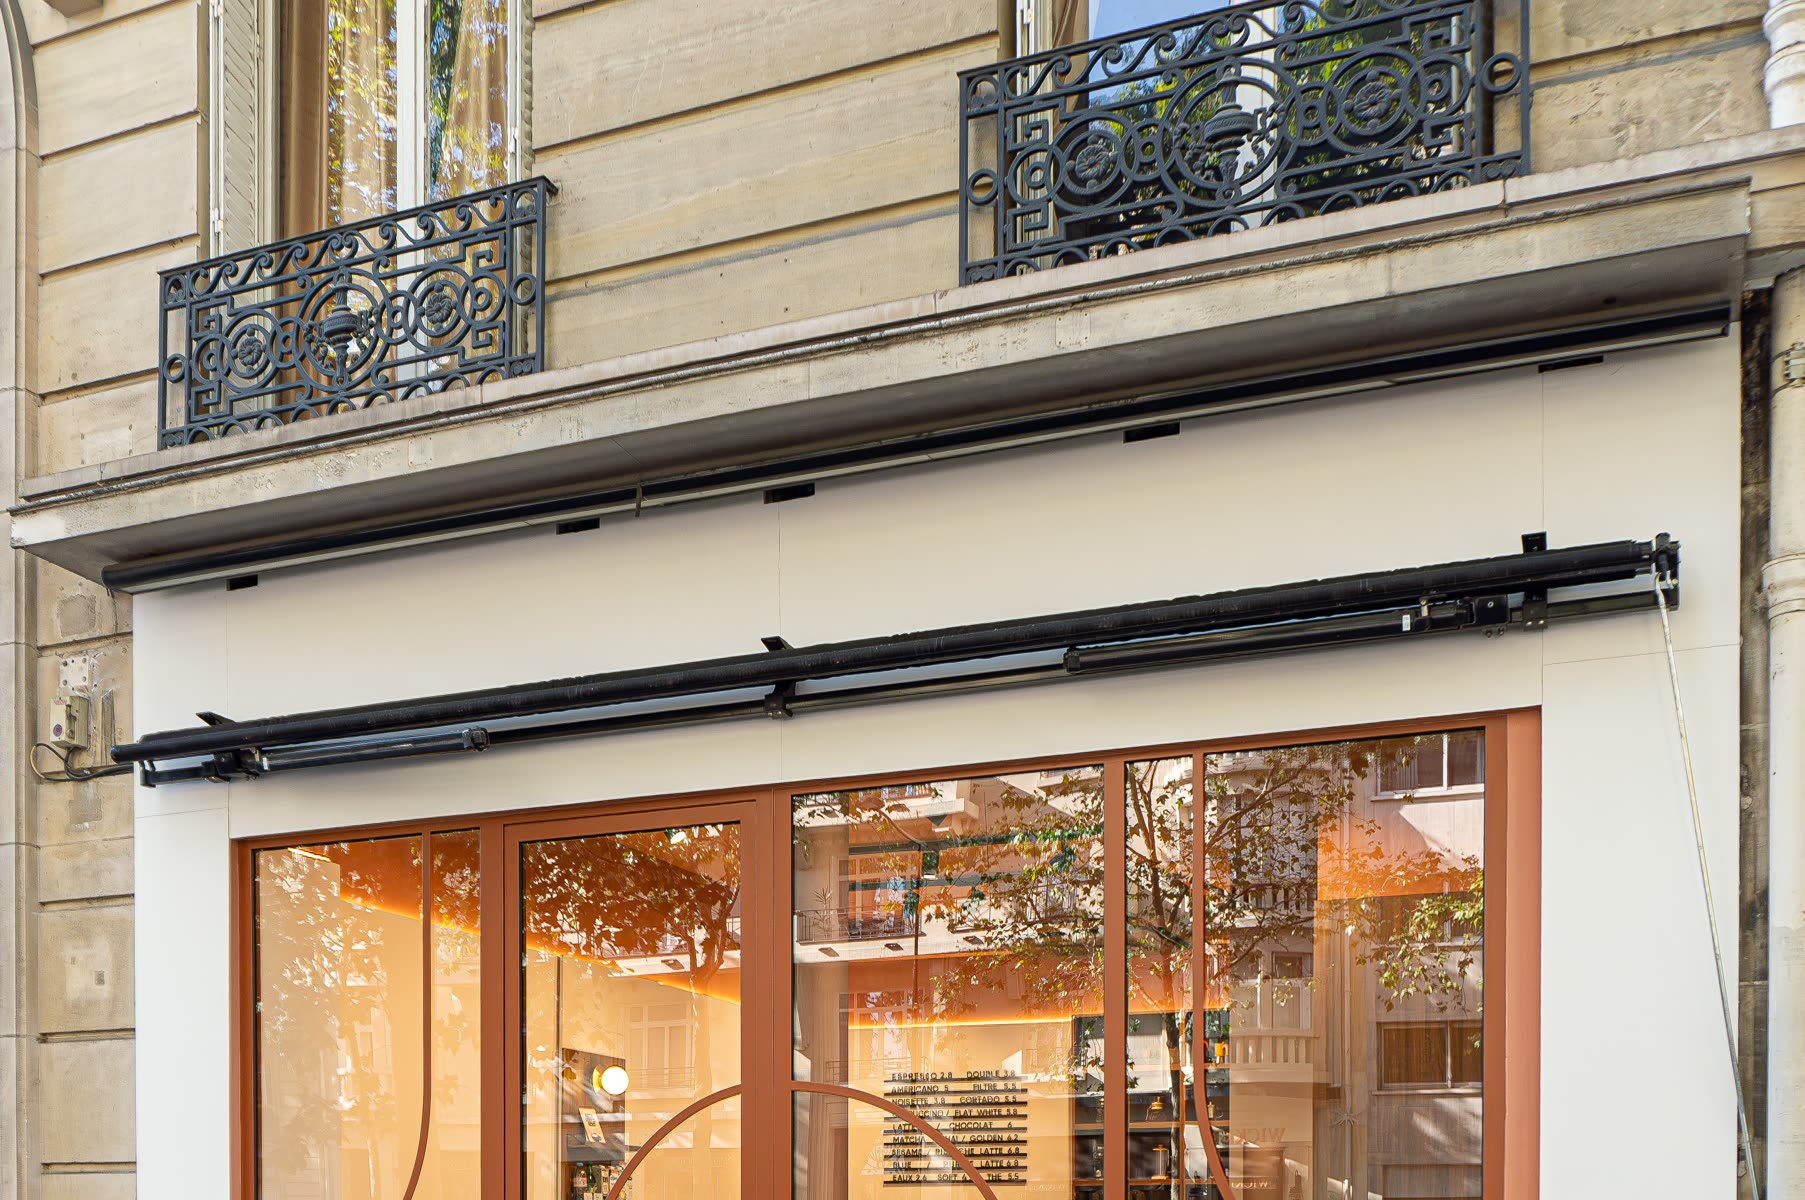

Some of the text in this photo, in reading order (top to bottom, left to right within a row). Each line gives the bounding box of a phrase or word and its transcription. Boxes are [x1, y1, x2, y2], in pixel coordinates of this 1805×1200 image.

[892, 1072, 938, 1081] ESPRESSO
[940, 1071, 953, 1080] 2.8
[966, 1070, 999, 1078] DOUBLE
[891, 1085, 939, 1093] AMERICANO
[972, 1083, 998, 1091] FILTRE
[892, 1098, 929, 1106] NOISETTE
[959, 1095, 1000, 1103] CORTADO
[954, 1109, 973, 1117] FLAT
[976, 1108, 1002, 1116] WHITE
[949, 1121, 993, 1129] CHOCOLAT
[893, 1136, 926, 1144] MATCHA
[969, 1134, 1003, 1142] GOLDEN
[936, 1148, 974, 1156] PICHE
[980, 1147, 1003, 1155] LATTE
[1007, 1146, 1020, 1154] 6.8
[893, 1161, 912, 1169] BLUE
[981, 1159, 1003, 1167] LATTE
[893, 1174, 913, 1182] EAUX
[938, 1173, 958, 1181] SOFT
